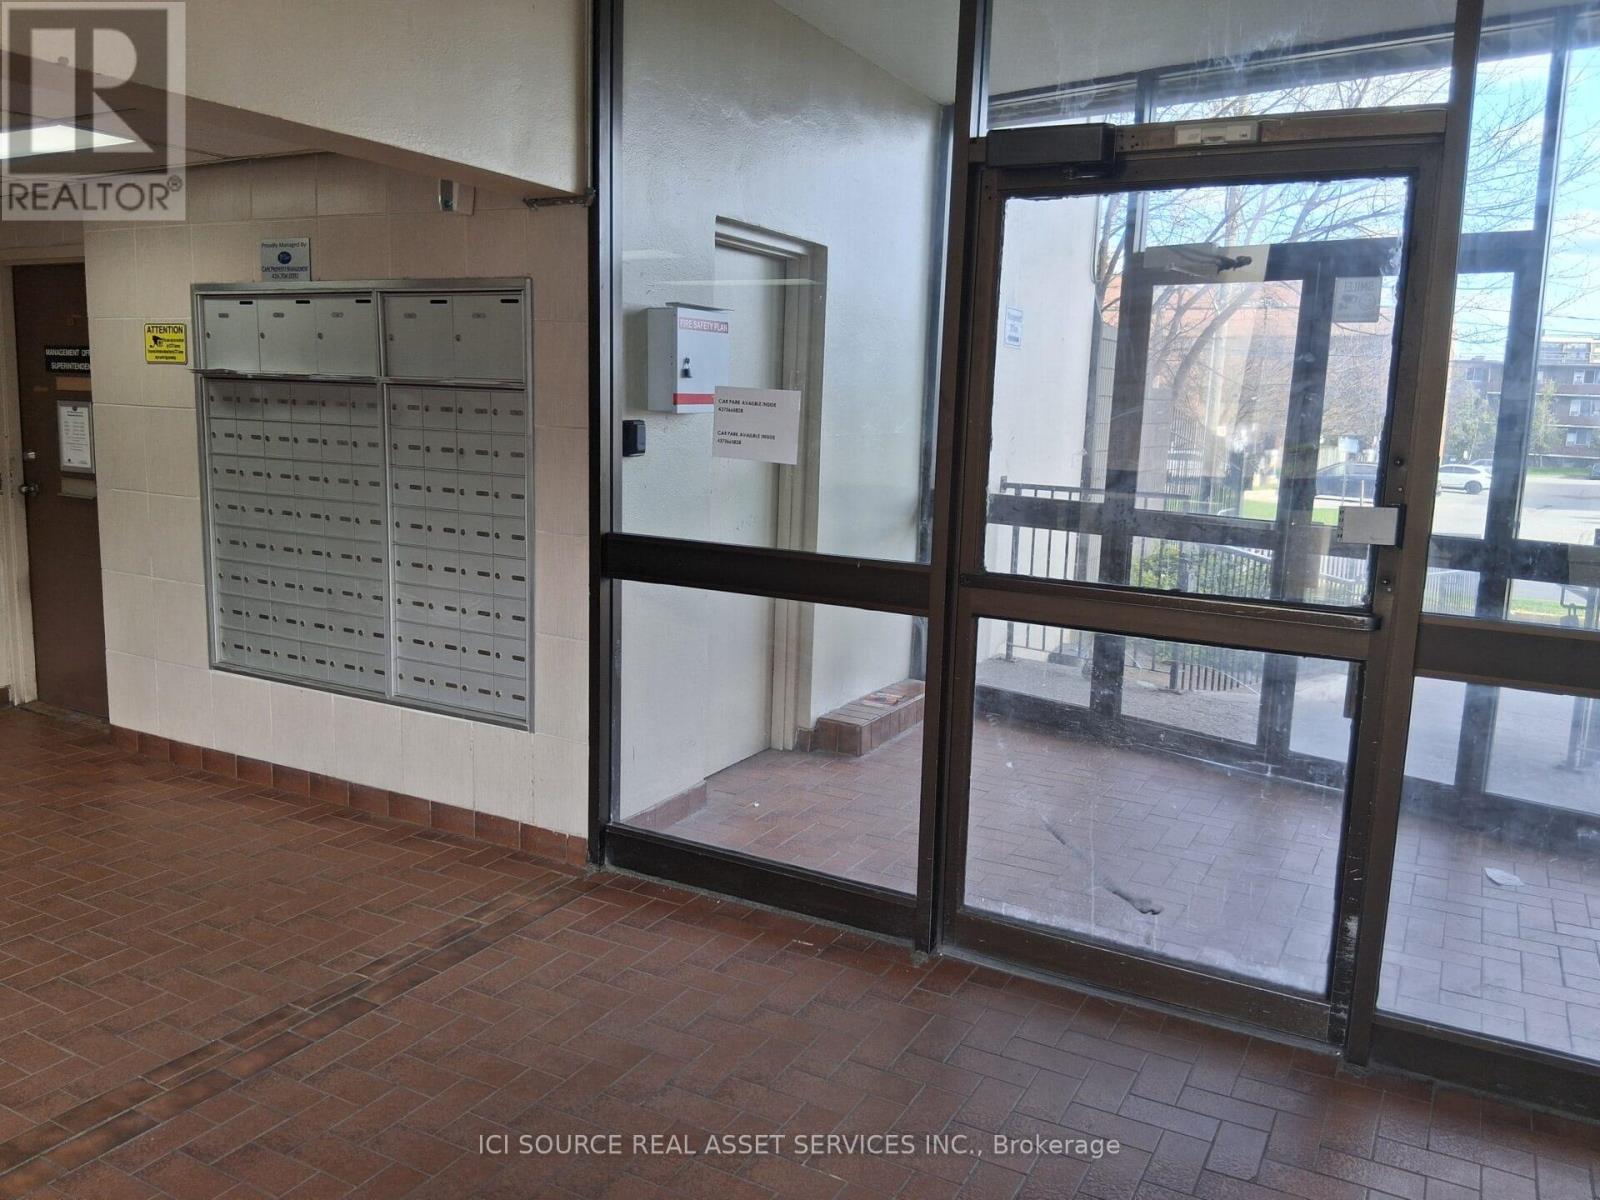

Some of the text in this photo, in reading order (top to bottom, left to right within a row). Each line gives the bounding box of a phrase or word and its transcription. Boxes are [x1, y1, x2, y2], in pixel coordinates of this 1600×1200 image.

[147, 325, 184, 334] ATTENTION
[679, 319, 728, 332] FIRE SAFETY PLAN
